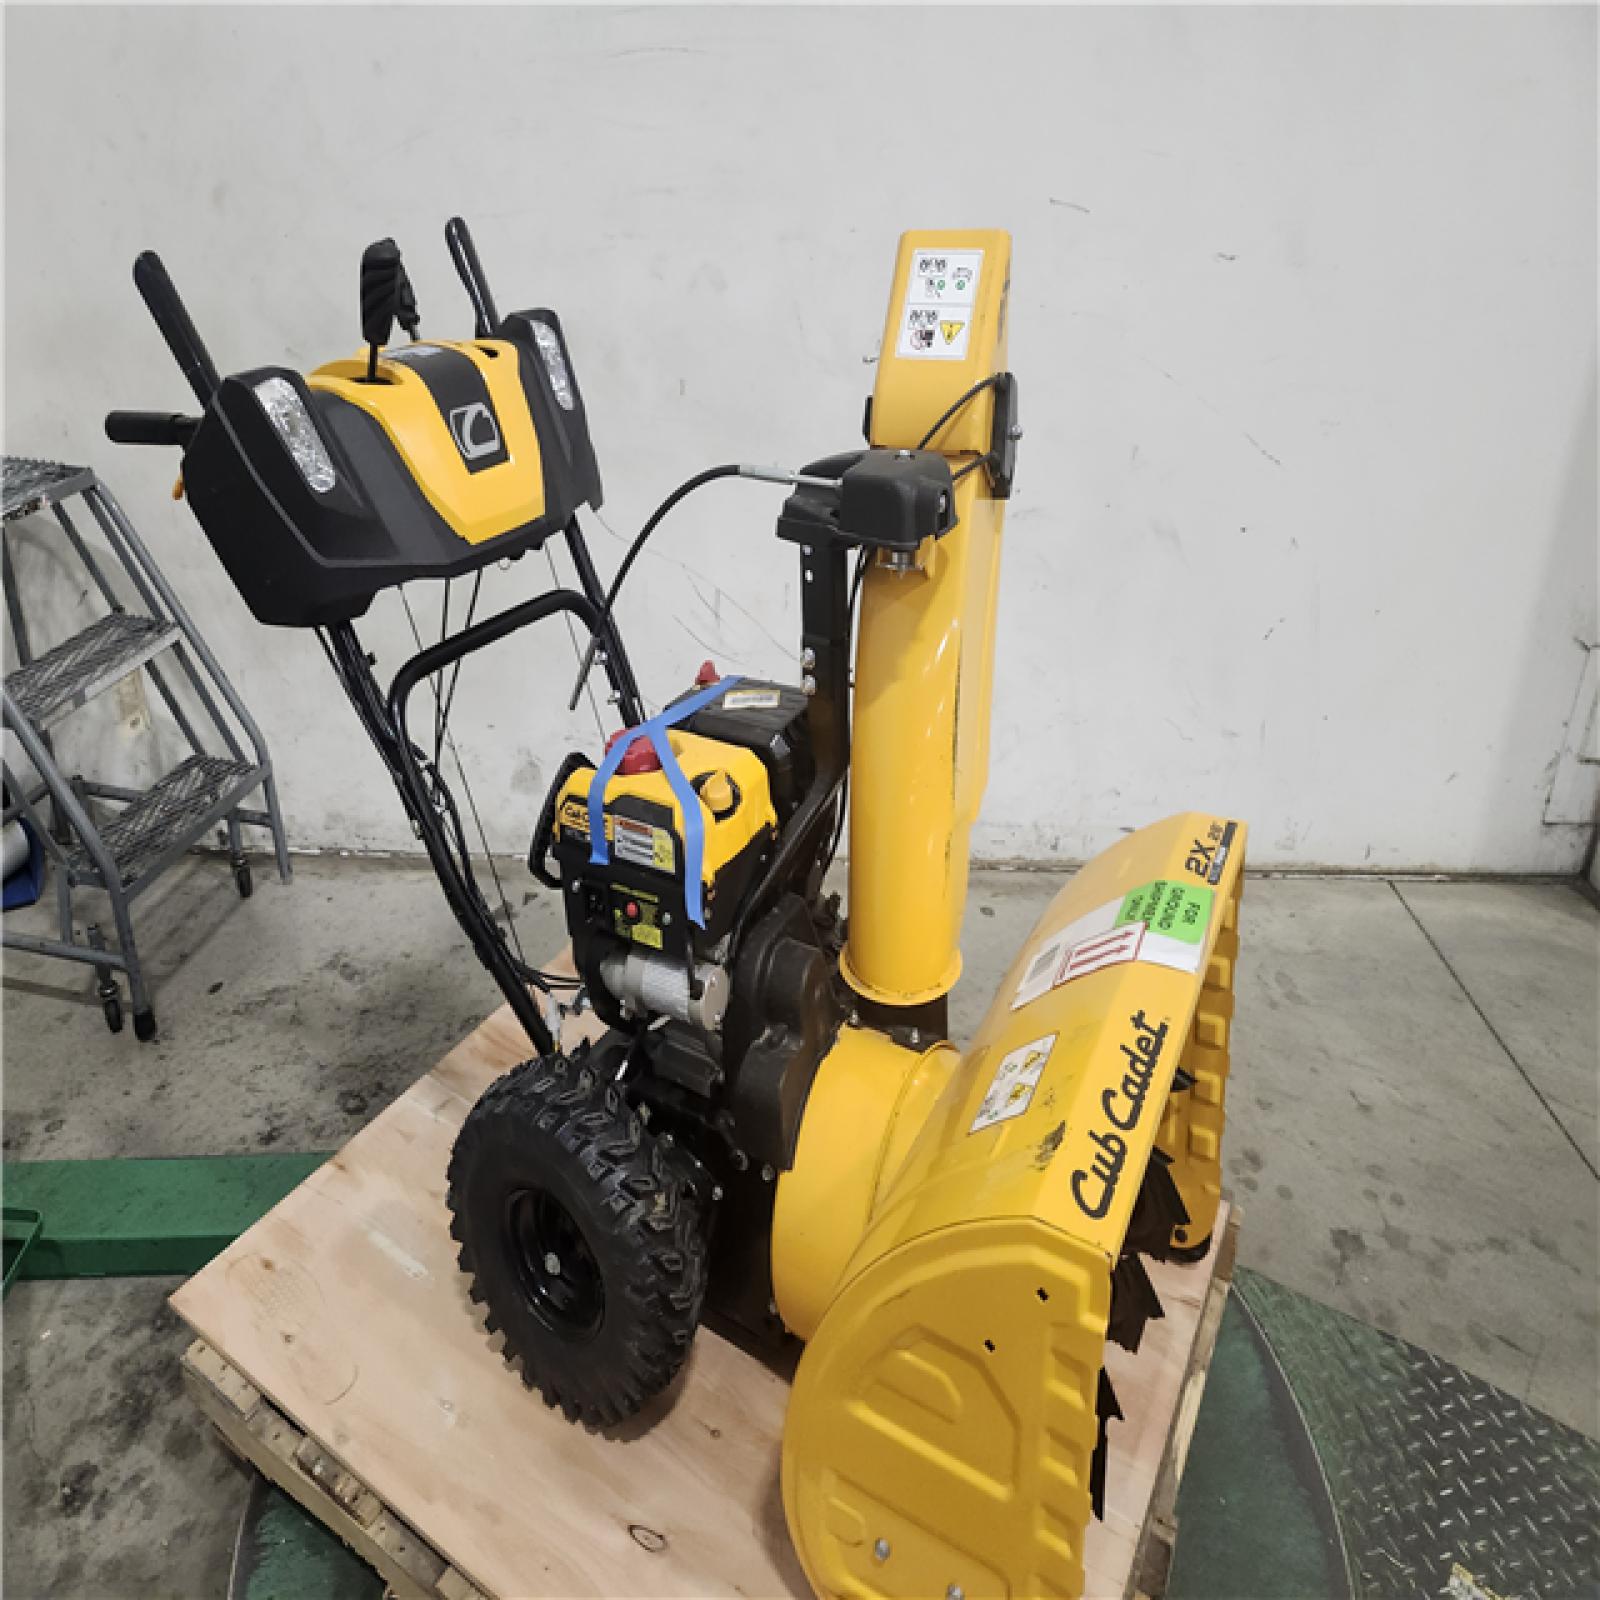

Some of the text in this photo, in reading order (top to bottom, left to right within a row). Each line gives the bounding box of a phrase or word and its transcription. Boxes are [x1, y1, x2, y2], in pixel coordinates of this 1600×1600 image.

[1185, 839, 1215, 877] 2X
[1157, 887, 1185, 930] GROUND
[1182, 902, 1201, 925] FOR
[1070, 1008, 1169, 1220] Cub Cadet
